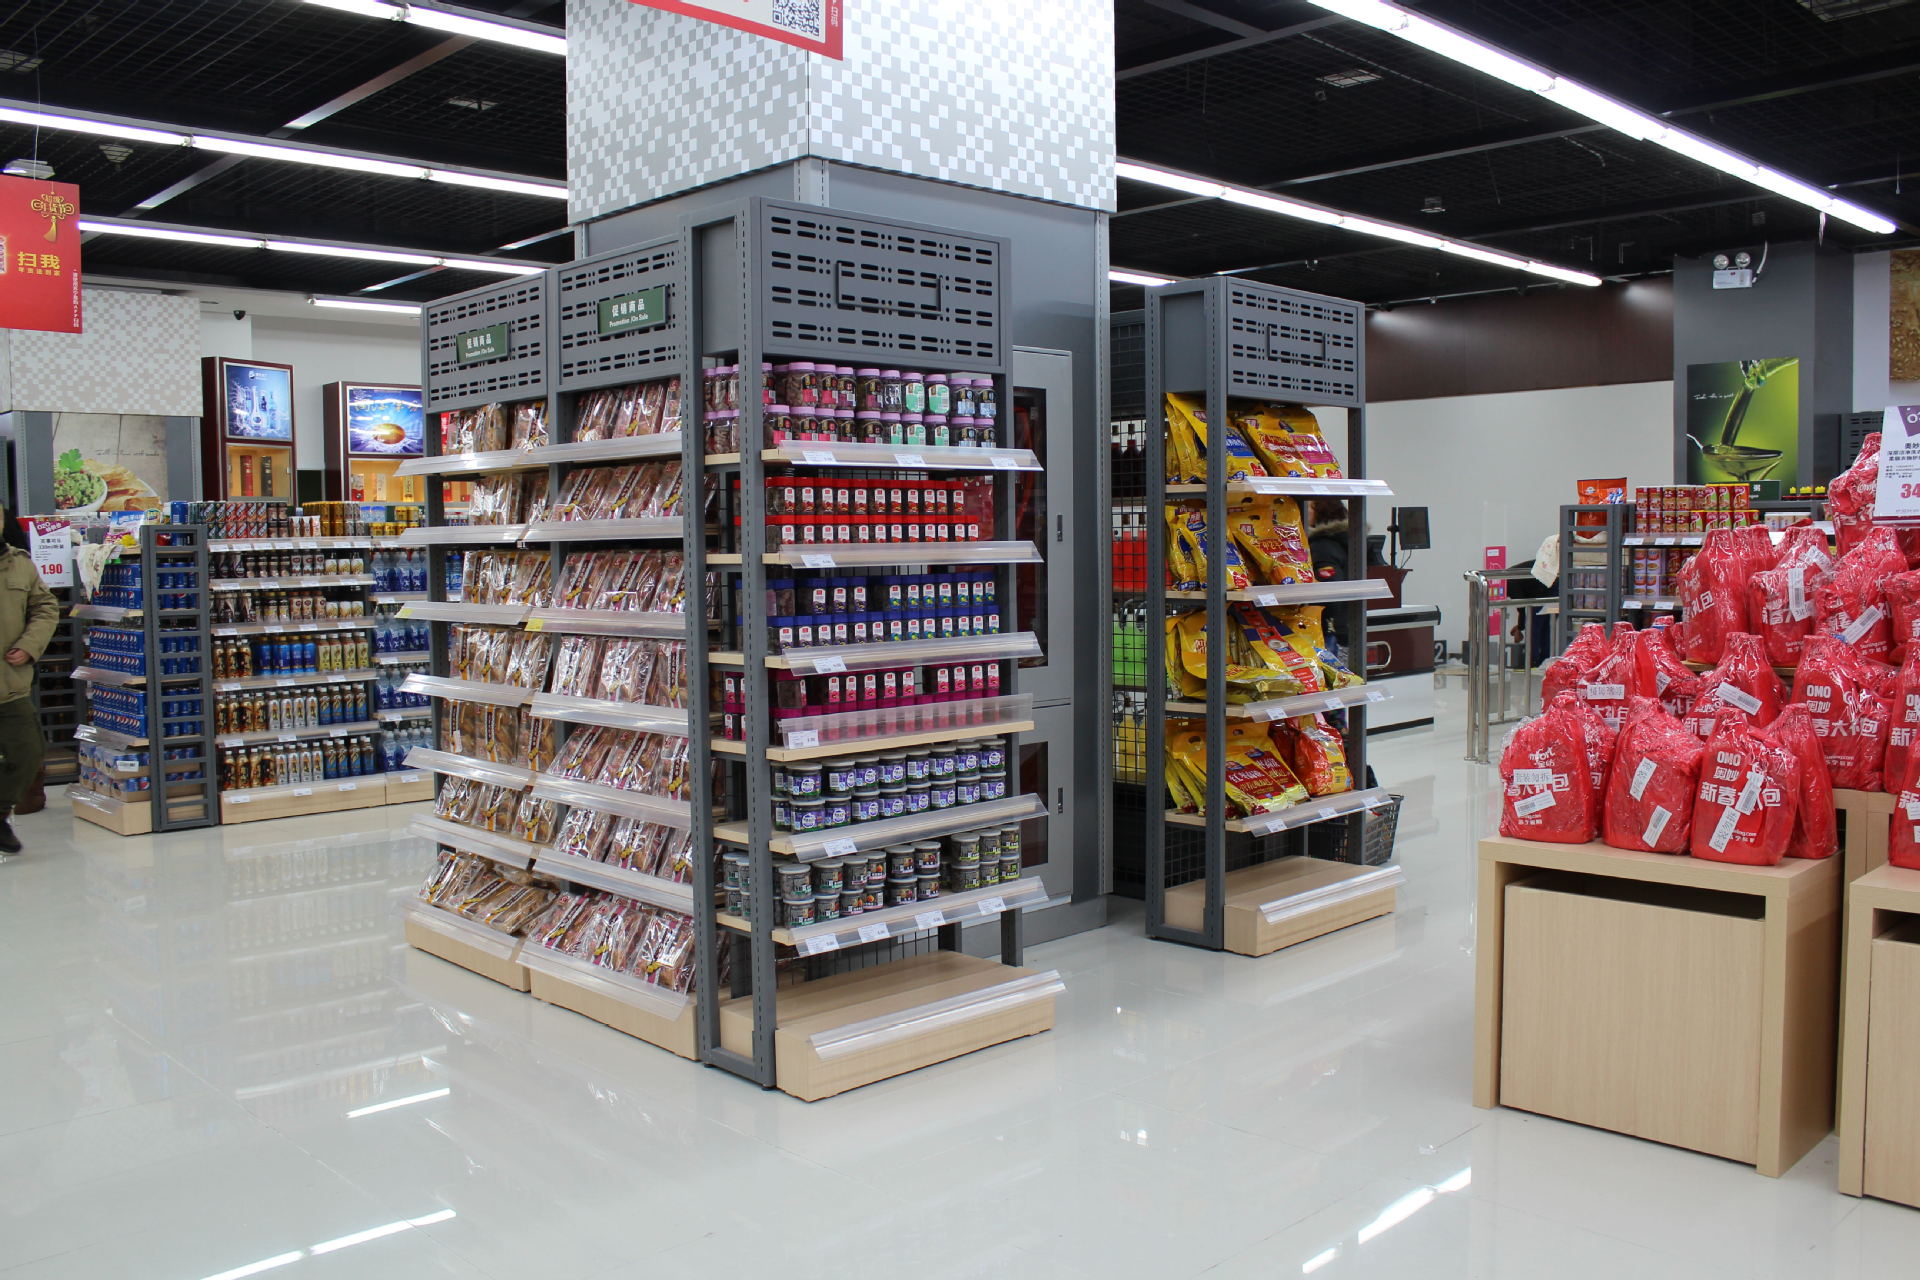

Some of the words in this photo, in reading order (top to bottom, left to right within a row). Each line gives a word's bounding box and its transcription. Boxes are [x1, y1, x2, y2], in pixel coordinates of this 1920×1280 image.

[17, 251, 61, 270] 扫我
[612, 298, 645, 318] 促销商品
[41, 563, 63, 575] 1.90
[1806, 684, 1832, 699] OMO
[1807, 699, 1831, 714] 奥妙
[1716, 750, 1741, 768] OMO
[1713, 766, 1740, 783] 奥妙
[1700, 781, 1781, 810] 新春包
